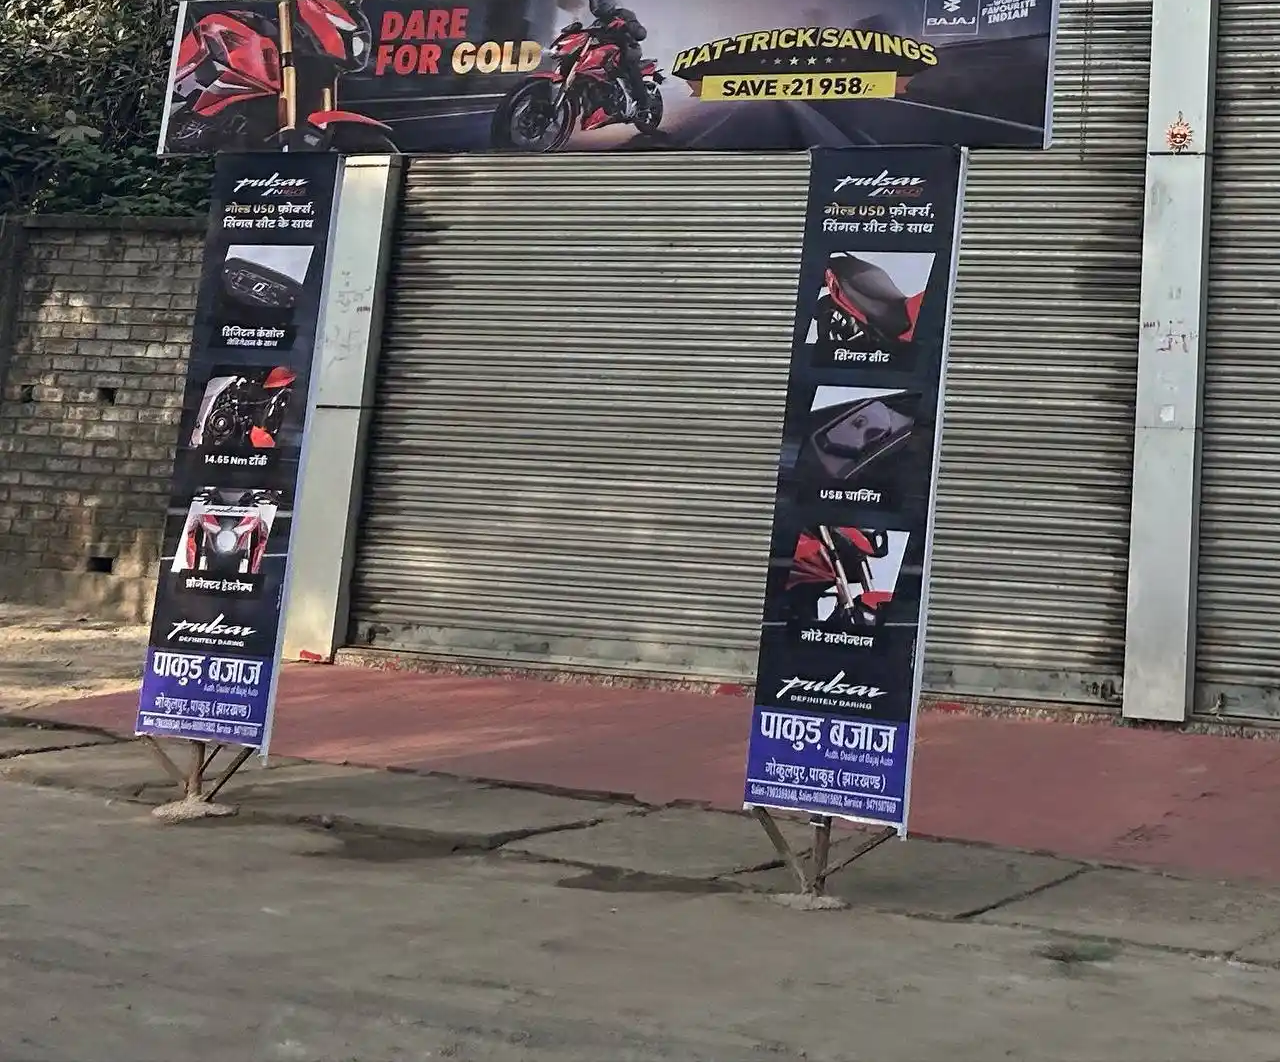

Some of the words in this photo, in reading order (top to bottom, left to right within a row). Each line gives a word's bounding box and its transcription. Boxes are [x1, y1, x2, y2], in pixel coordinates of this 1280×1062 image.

[926, 17, 977, 26] BAJAJ
[987, 8, 1029, 24] INDIAN
[380, 8, 469, 41] DARE
[673, 27, 819, 73] HAT-TRICK
[820, 27, 939, 66] SAVINGS
[375, 44, 442, 76] FOR
[451, 41, 543, 74] GOLD
[722, 80, 777, 97] SAVE
[253, 204, 275, 214] USD
[859, 205, 885, 216] USD
[255, 216, 276, 229] सीट
[278, 216, 289, 229] के
[291, 219, 313, 229] साथ
[822, 218, 860, 233] सिंगल
[862, 219, 888, 233] सीट
[890, 219, 904, 233] के
[907, 222, 934, 234] साथ
[834, 349, 867, 362] सिंगल
[868, 350, 890, 363] सीट
[204, 455, 229, 465] 14.65
[230, 456, 248, 466] Nm
[820, 489, 843, 500] USB
[167, 612, 257, 640] pulsar
[153, 651, 206, 686] पाकुड़
[208, 657, 263, 685] बजाज
[776, 670, 889, 699] pulsar
[790, 695, 838, 706] DEFINITELY
[839, 700, 872, 710] DARING
[760, 711, 825, 751] पाकुड़
[829, 719, 897, 754] बजाज
